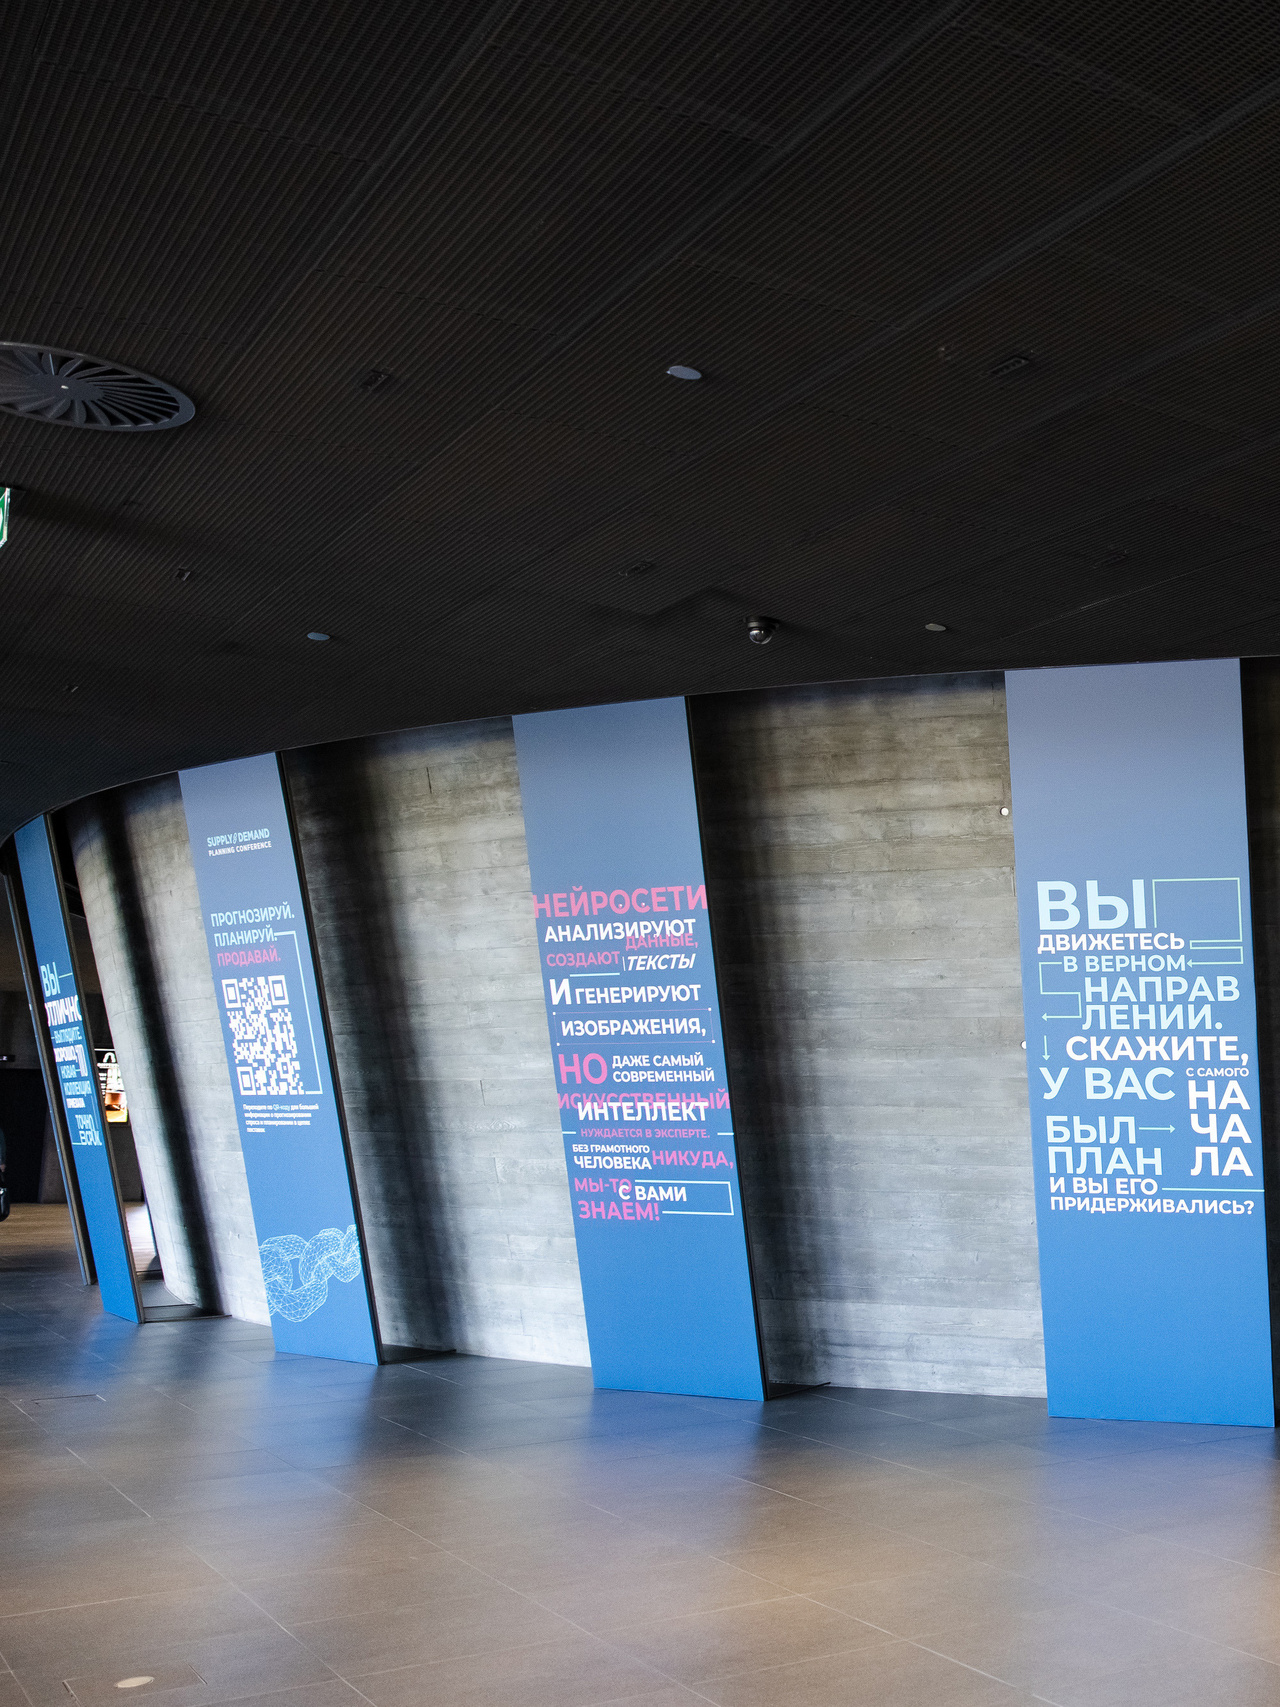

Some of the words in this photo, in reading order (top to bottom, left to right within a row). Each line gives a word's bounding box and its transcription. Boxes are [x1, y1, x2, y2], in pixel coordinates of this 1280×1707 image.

[207, 833, 233, 847] SUPPLY
[238, 828, 269, 842] DEMAND
[209, 847, 235, 856] PLANNING
[236, 841, 272, 852] CONFERENCE
[533, 885, 707, 918] НЕЙРОСЕТИ
[1037, 879, 1147, 931] ВЫ
[211, 902, 294, 927] ПРОГНОЗИРУЙ.
[214, 925, 277, 947] ПЛАНИРУЙ.
[545, 919, 696, 942] АНАЛИЗИРУЮТ
[626, 933, 698, 951] ДАННЫЕ,
[1037, 932, 1185, 954] ДВИЖЕТЕСЬ
[217, 945, 281, 967] ПРОДАВАЙ.
[547, 951, 620, 967] СОЗДАЮТ
[628, 953, 696, 971] ТЕКСТЫ
[1063, 956, 1078, 972] В
[1085, 954, 1186, 972] ВЕРНОМ
[40, 962, 60, 997] ВЫ
[1084, 976, 1240, 1002] НАПРАВ
[549, 978, 572, 1005] И
[575, 984, 701, 1005] ГЕНЕРИРУЮТ
[561, 1017, 706, 1037] ИЗОБРАЖЕНИЯ,
[1082, 1004, 1223, 1030] ЛЕНИИ.
[612, 1055, 650, 1068] ДАЖЕ
[653, 1052, 704, 1067] САМЫЙ
[1065, 1036, 1249, 1065] СКАЖИТЕ,
[558, 1053, 607, 1084] НО
[612, 1068, 714, 1083] СОВРЕМЕННЫЙ
[1186, 1068, 1195, 1077] С
[1197, 1066, 1249, 1077] САМОГО
[1039, 1067, 1069, 1100] У
[1085, 1067, 1175, 1100] ВАС
[1189, 1080, 1250, 1110] НА
[578, 1102, 708, 1121] ИНТЕЛЛЕКТ
[581, 1129, 642, 1138] НУЖДАЕТСЯ
[646, 1129, 652, 1138] В
[655, 1129, 710, 1138] ЭКСПЕРТЕ.
[1046, 1115, 1136, 1144] БЫЛ
[1190, 1113, 1252, 1144] ЧА
[572, 1144, 589, 1153] БЕЗ
[591, 1145, 649, 1154] ГРАМОТНОГО
[574, 1156, 652, 1170] ЧЕЛОВЕКА
[652, 1150, 734, 1169] НИКУДА,
[1048, 1146, 1163, 1175] ПЛАН
[1190, 1146, 1254, 1177] ЛА
[574, 1178, 632, 1193] МЫ-ТО
[619, 1185, 630, 1200] С
[635, 1186, 687, 1201] ВАМИ
[1050, 1177, 1065, 1194] И
[1072, 1177, 1108, 1194] ВЫ
[1116, 1178, 1158, 1196] ЕГО
[578, 1201, 660, 1221] ЗНАЕМ!
[1050, 1196, 1255, 1215] ПРИДЕРЖИВАЛИСЬ?
